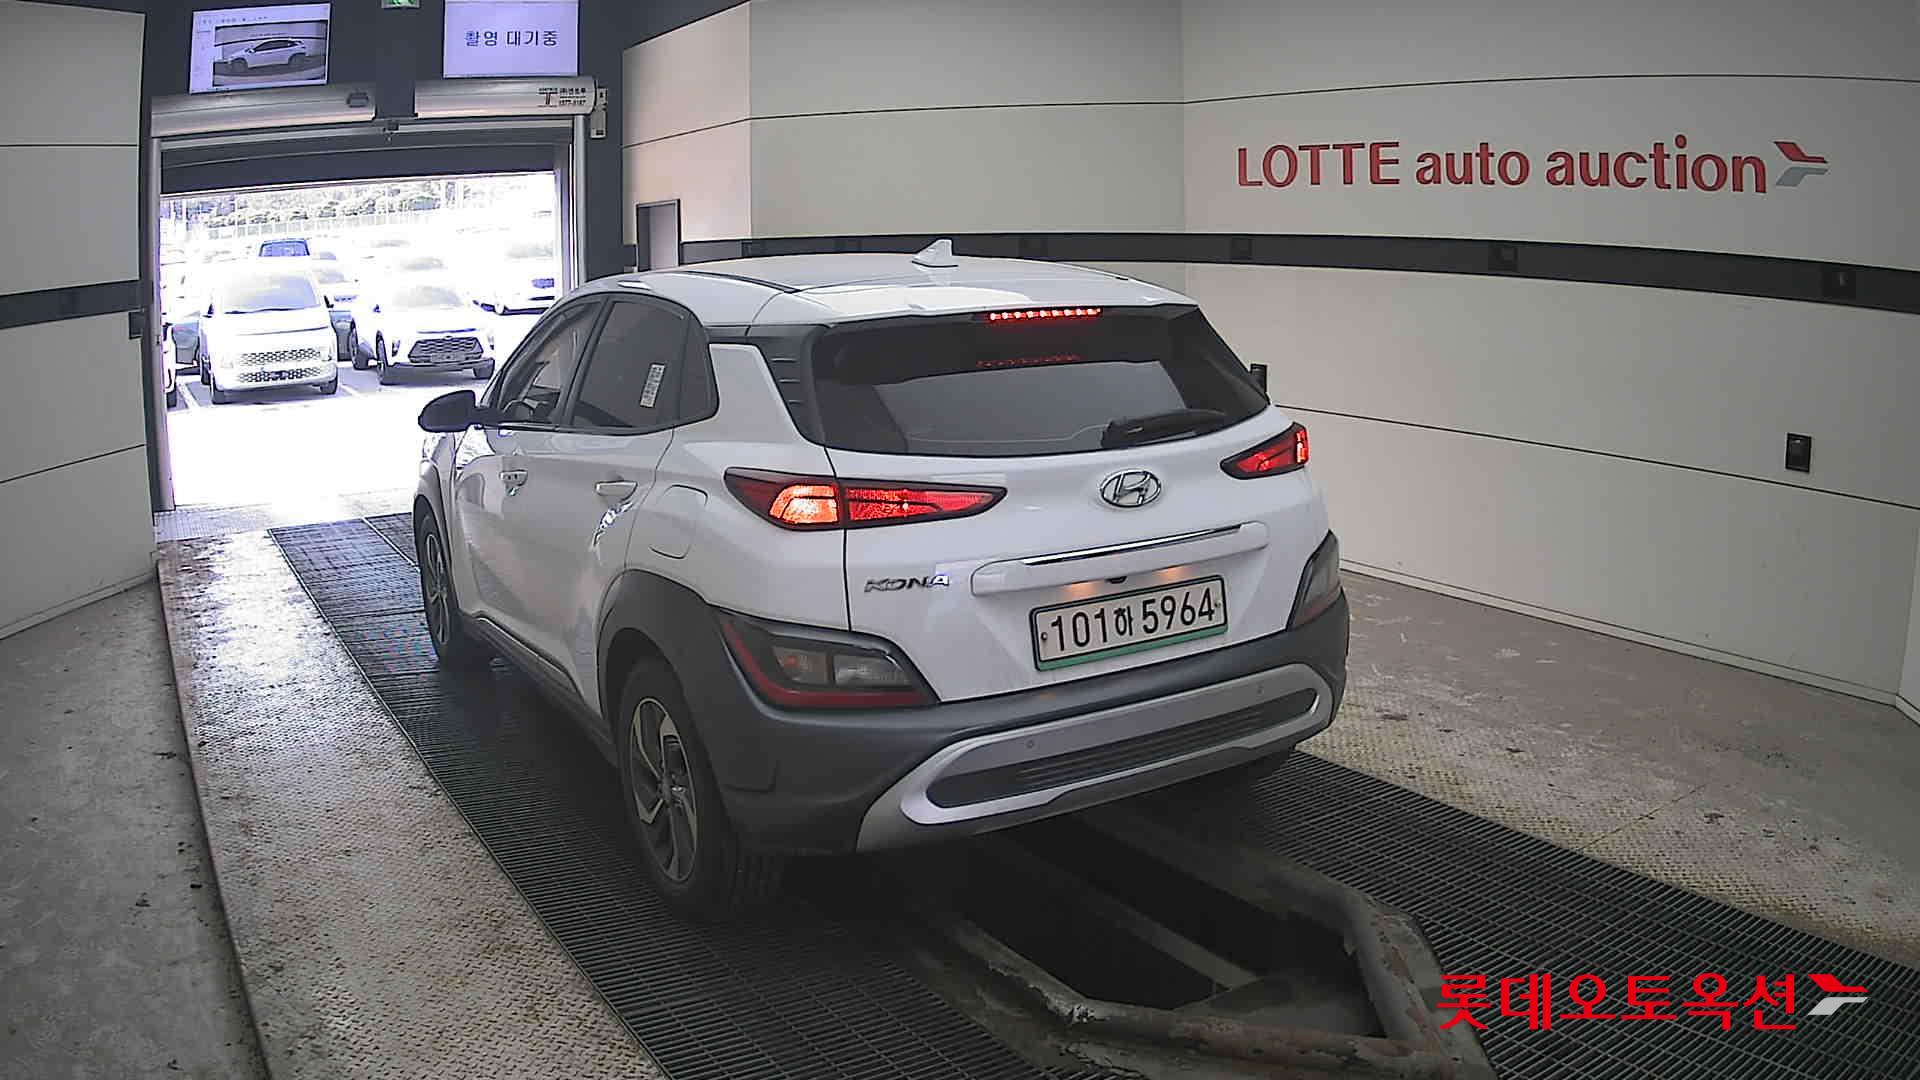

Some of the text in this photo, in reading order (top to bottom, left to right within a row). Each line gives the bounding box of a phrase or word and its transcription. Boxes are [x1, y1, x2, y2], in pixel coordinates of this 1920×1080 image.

[464, 30, 557, 47] 촬영 대기중
[1238, 135, 1767, 193] LOTTE auto auction
[864, 575, 950, 592] KONA
